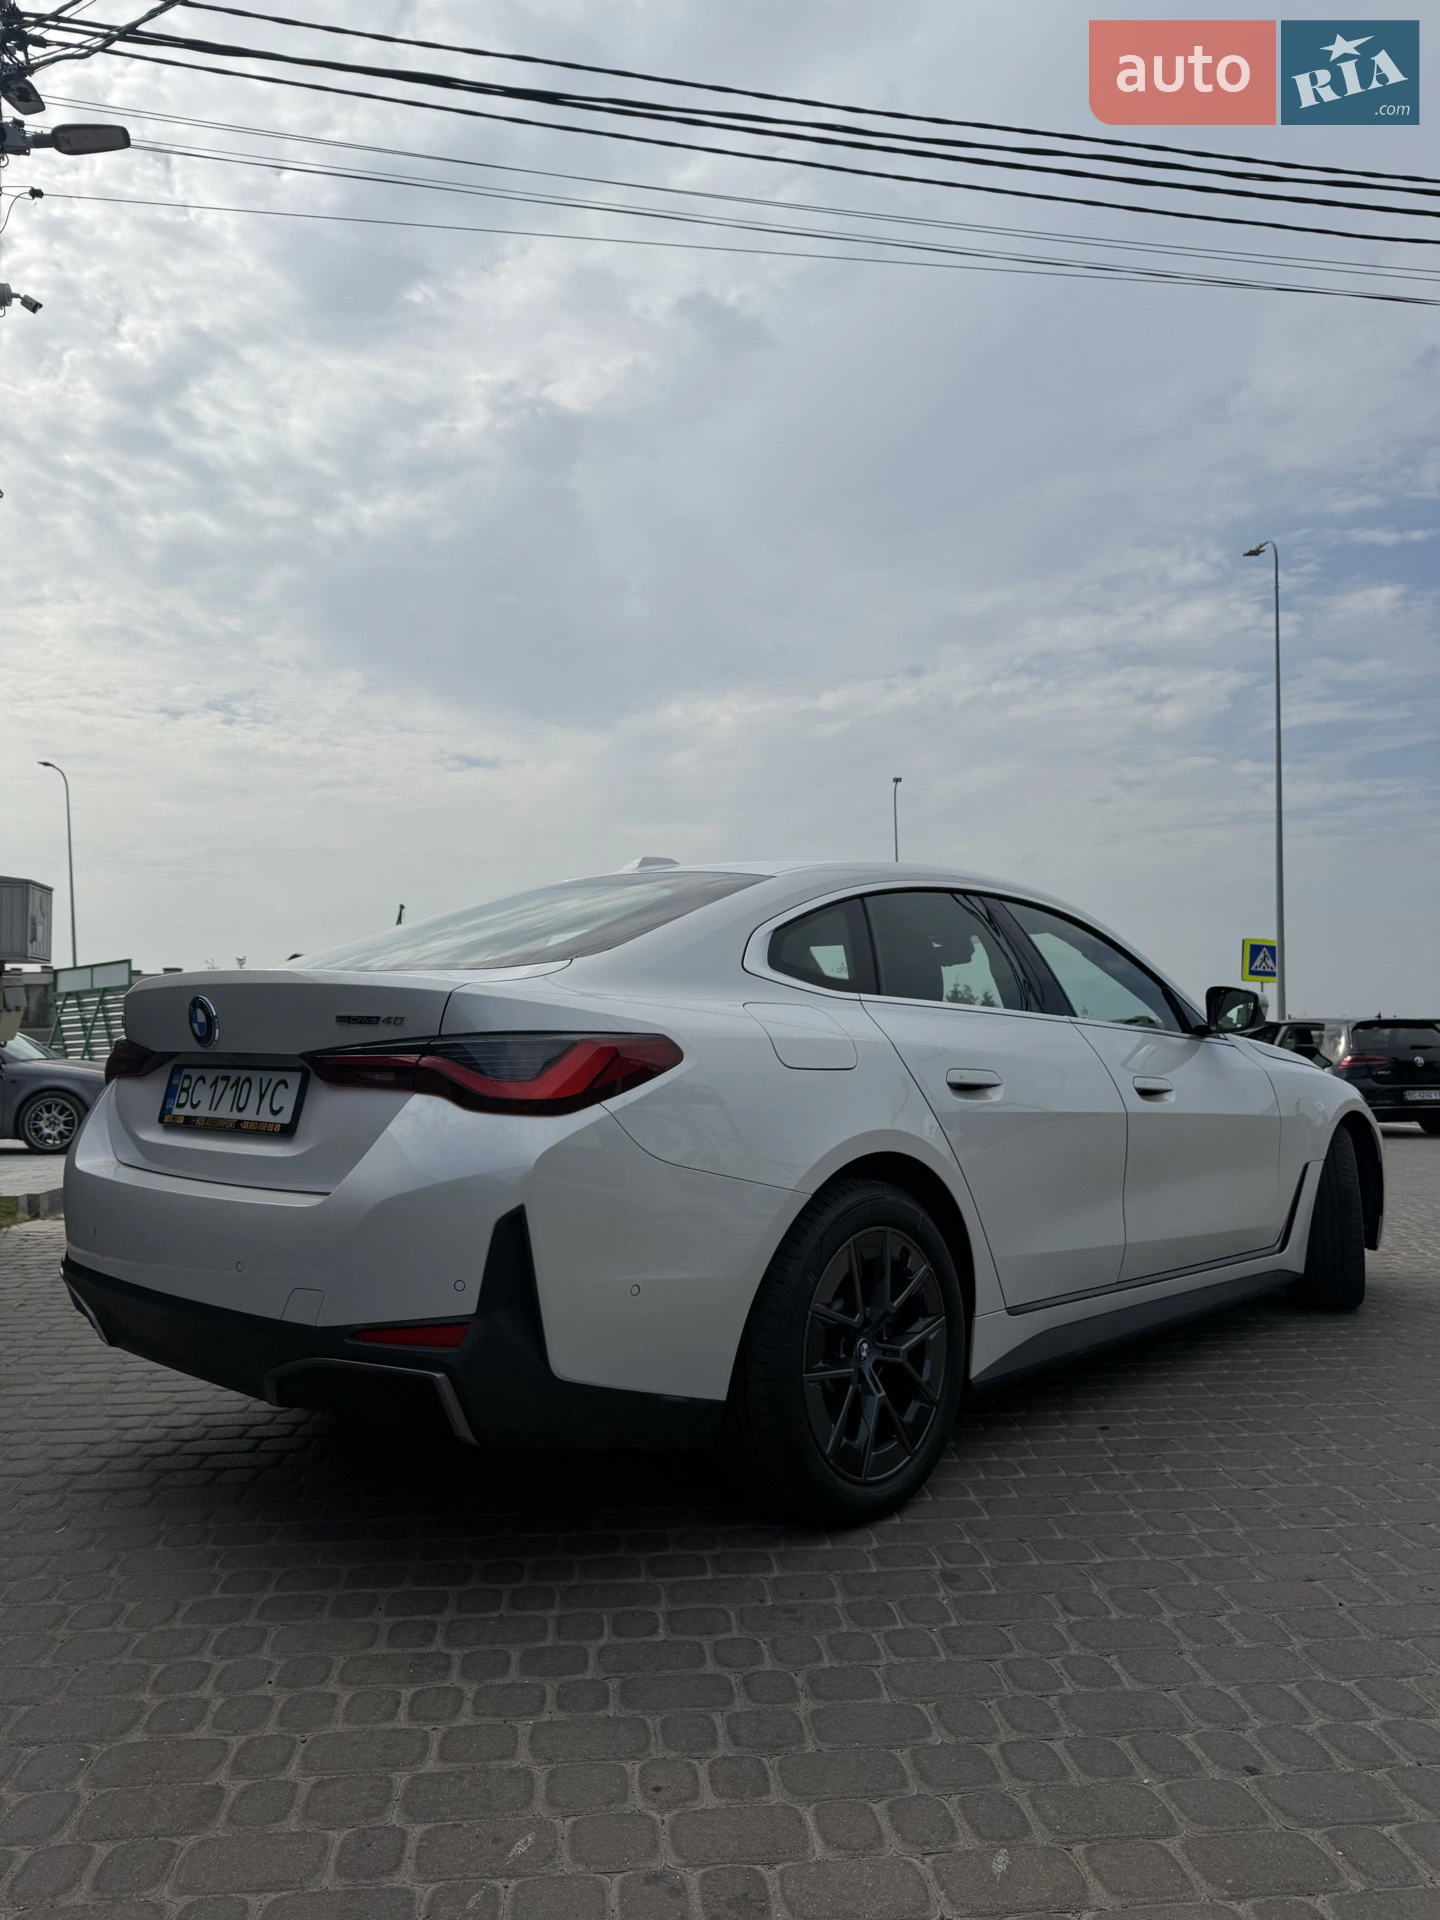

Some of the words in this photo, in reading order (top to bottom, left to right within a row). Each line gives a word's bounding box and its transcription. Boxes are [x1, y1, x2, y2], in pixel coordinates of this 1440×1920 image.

[175, 1074, 206, 1110] BC
[209, 1075, 253, 1113] 1710
[256, 1077, 289, 1116] YC
